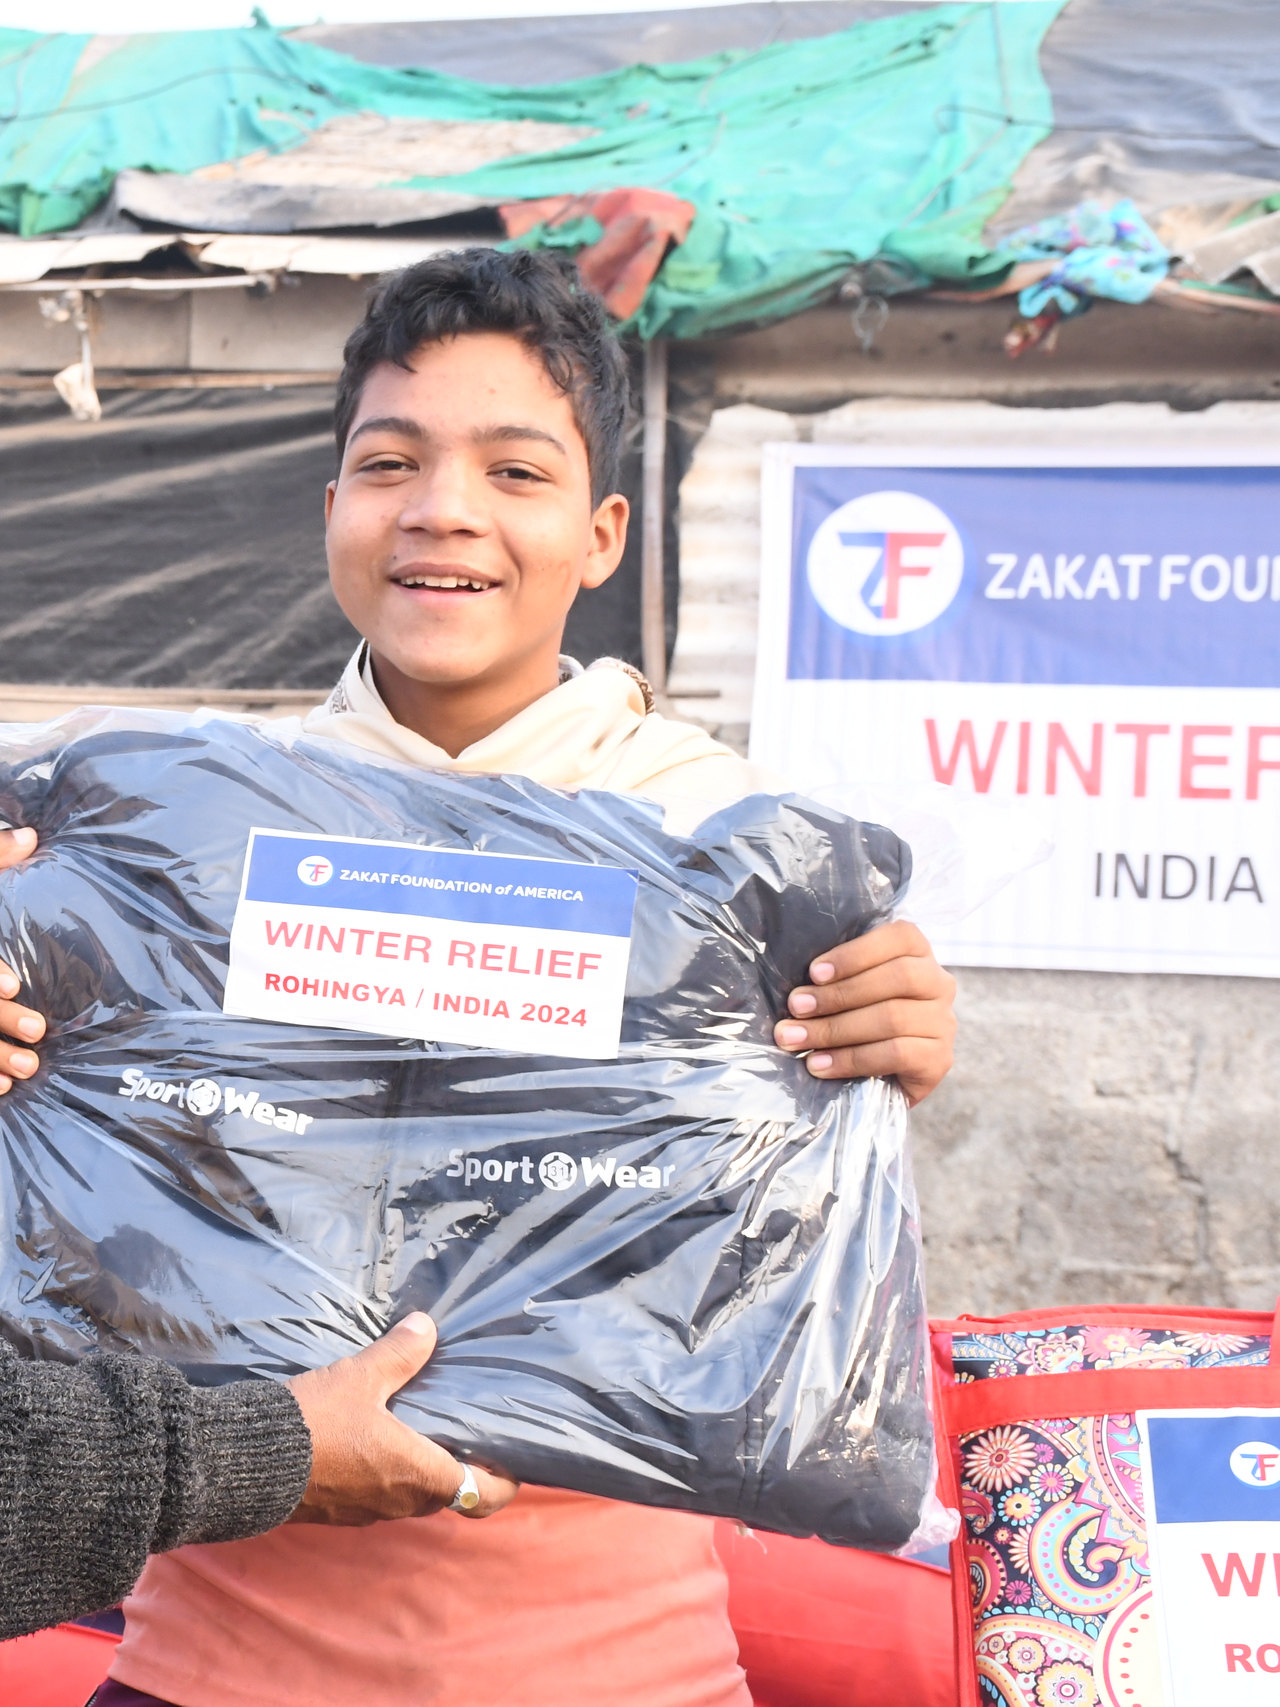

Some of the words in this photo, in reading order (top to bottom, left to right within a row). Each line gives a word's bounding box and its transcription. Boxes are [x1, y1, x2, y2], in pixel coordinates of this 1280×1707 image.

[984, 553, 1153, 601] ZAKAT
[1158, 553, 1280, 602] FOU
[339, 869, 390, 885] ZAKAT
[390, 873, 492, 895] FOUNDATION
[495, 884, 513, 897] of
[513, 885, 584, 902] AMERICA
[1094, 851, 1264, 903] INDIA
[264, 919, 433, 964] WINTER
[447, 939, 603, 981] RELIEF
[264, 972, 407, 1008] ROHINGYA
[415, 988, 425, 1009] /
[432, 992, 511, 1019] INDIA
[520, 1002, 588, 1028] 2024
[118, 1068, 187, 1110] Sport
[224, 1086, 314, 1136] Wear
[446, 1148, 535, 1187] Sport
[580, 1155, 676, 1189] Wear
